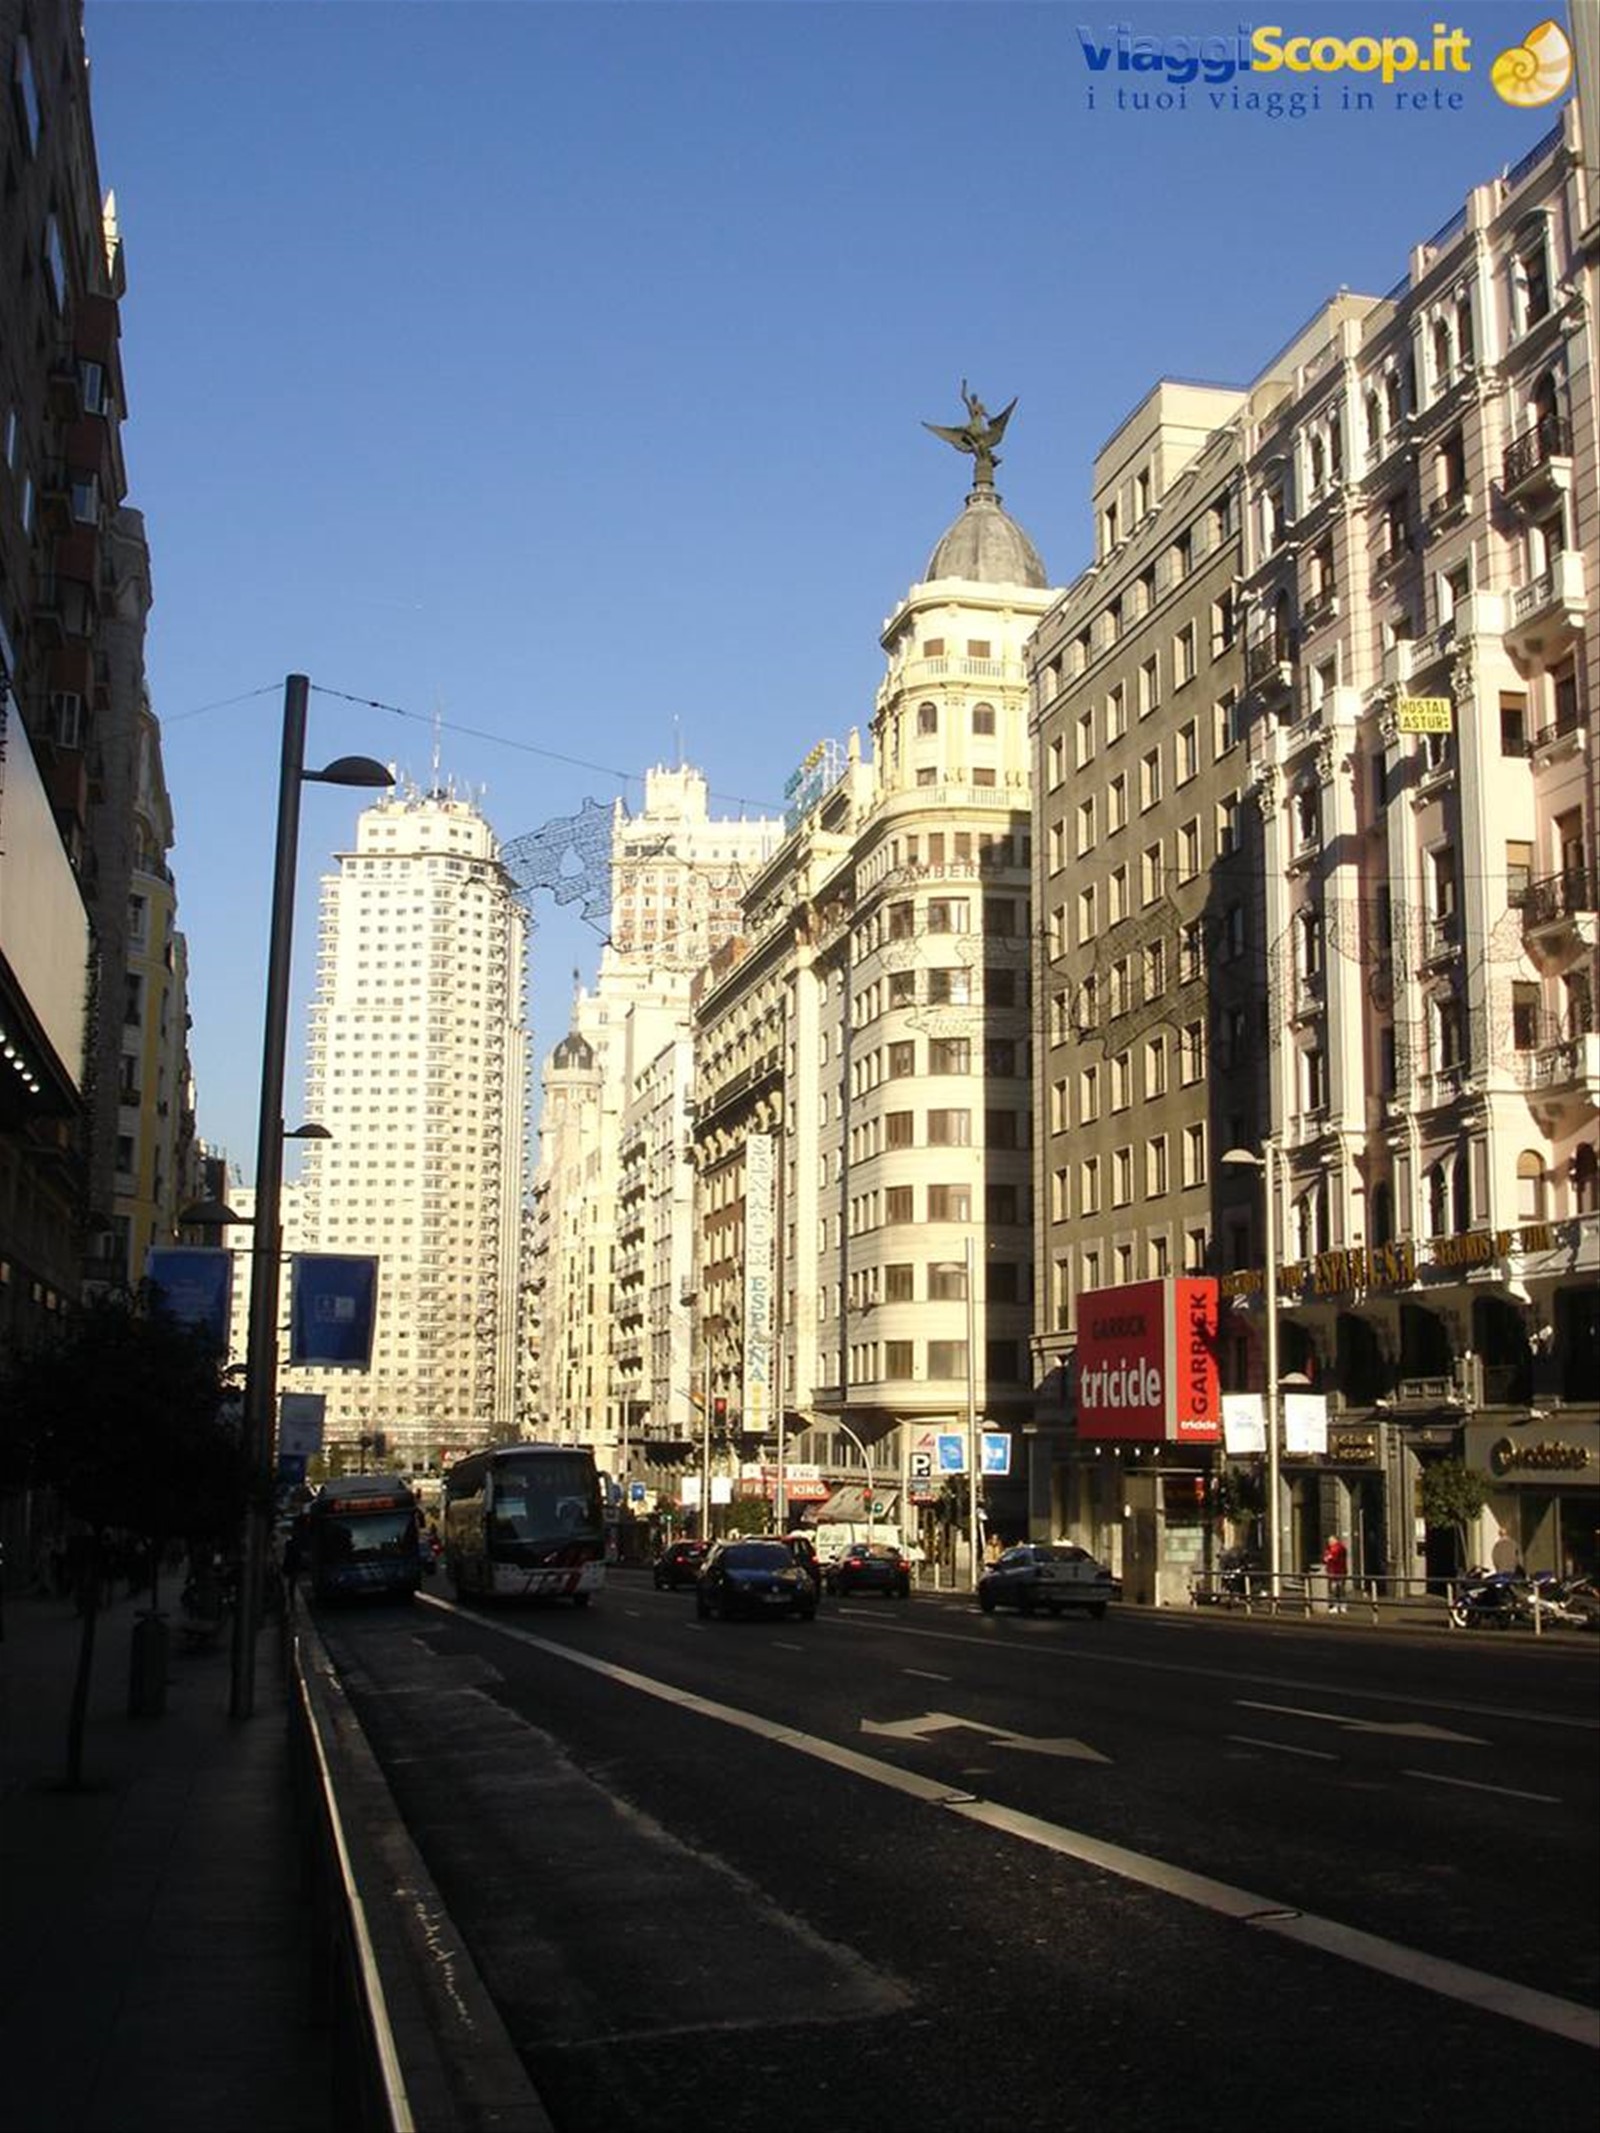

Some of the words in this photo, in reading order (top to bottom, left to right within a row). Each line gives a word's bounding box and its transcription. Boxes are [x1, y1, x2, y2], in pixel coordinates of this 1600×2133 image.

[1401, 701, 1447, 714] HOSTAL
[1080, 1357, 1161, 1408] tricicle
[912, 1454, 930, 1477] P
[793, 1483, 826, 1496] KING
